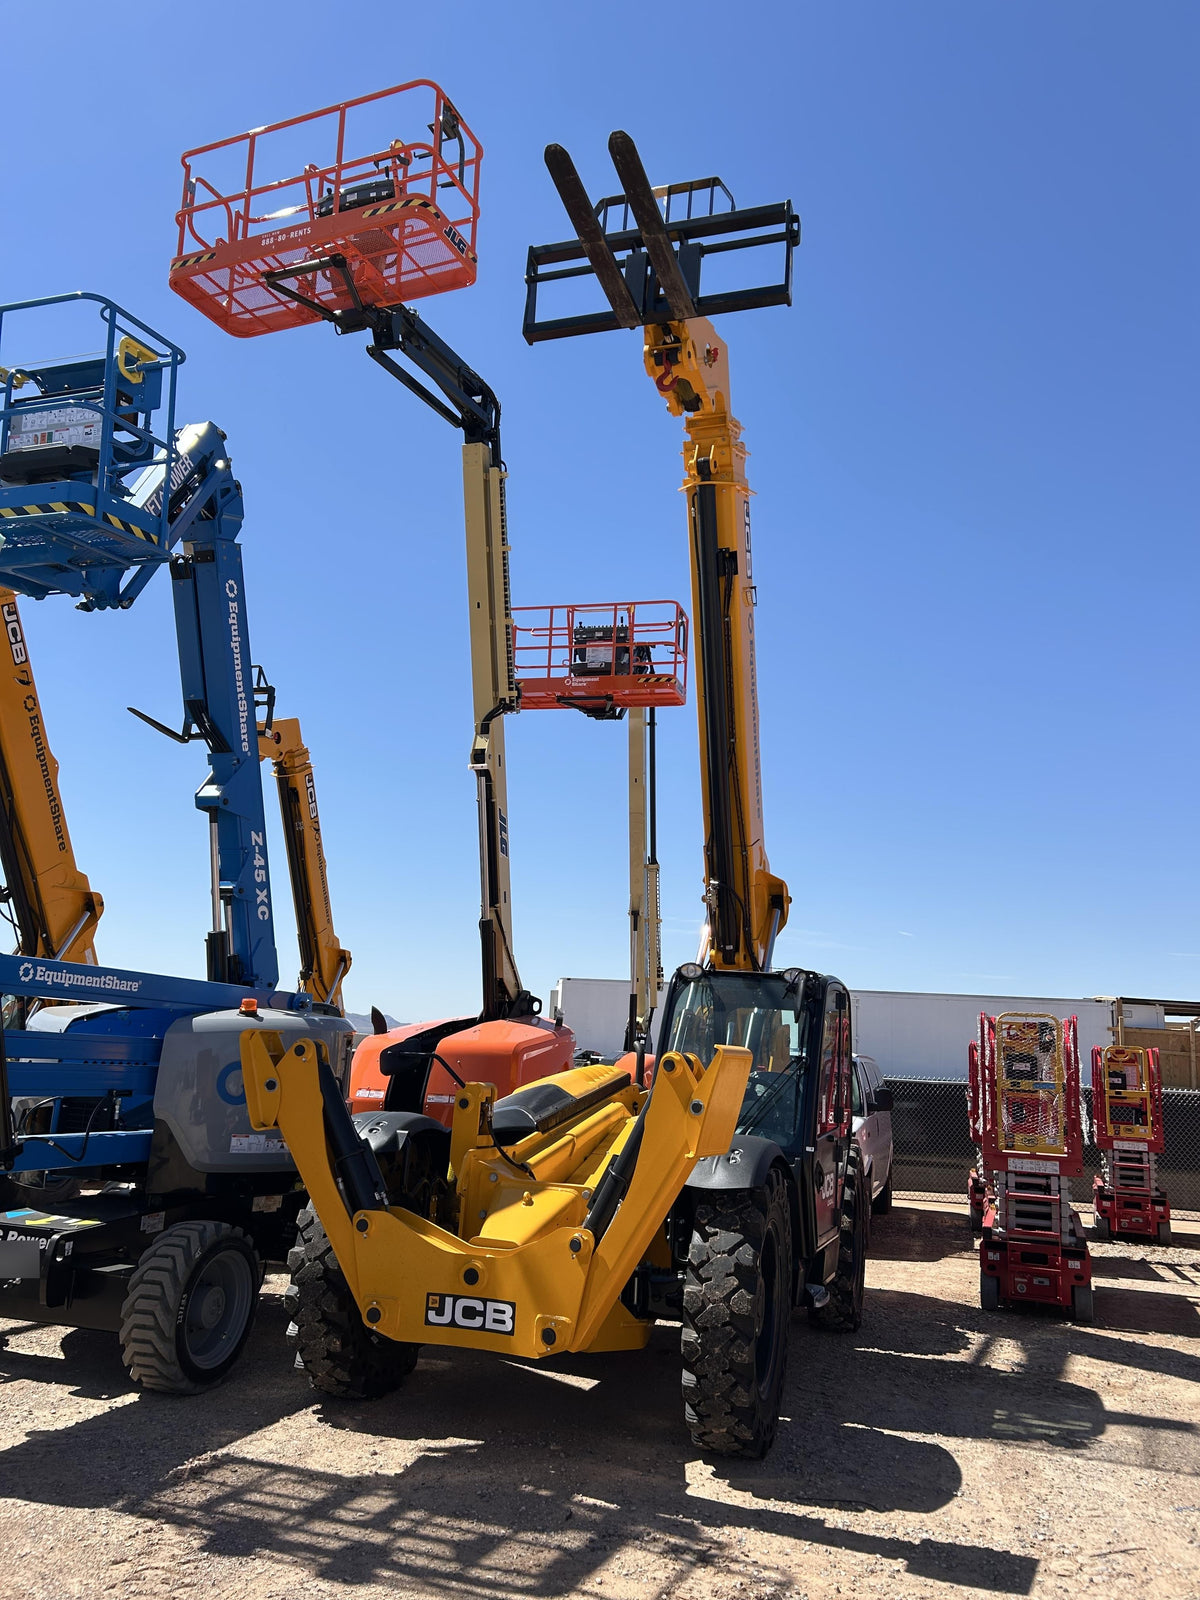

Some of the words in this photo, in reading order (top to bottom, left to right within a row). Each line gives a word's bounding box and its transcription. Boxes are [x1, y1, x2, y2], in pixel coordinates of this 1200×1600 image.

[443, 225, 468, 258] JLG
[3, 604, 27, 664] JCB
[228, 601, 249, 752] EquipmentShare
[28, 713, 66, 852] EquipmentShare
[305, 774, 317, 819] JCB
[250, 830, 266, 883] Z-45
[498, 807, 508, 858] JLG
[255, 888, 270, 921] XC
[35, 966, 139, 992] EquipmentShare
[427, 1296, 514, 1332] JCB
